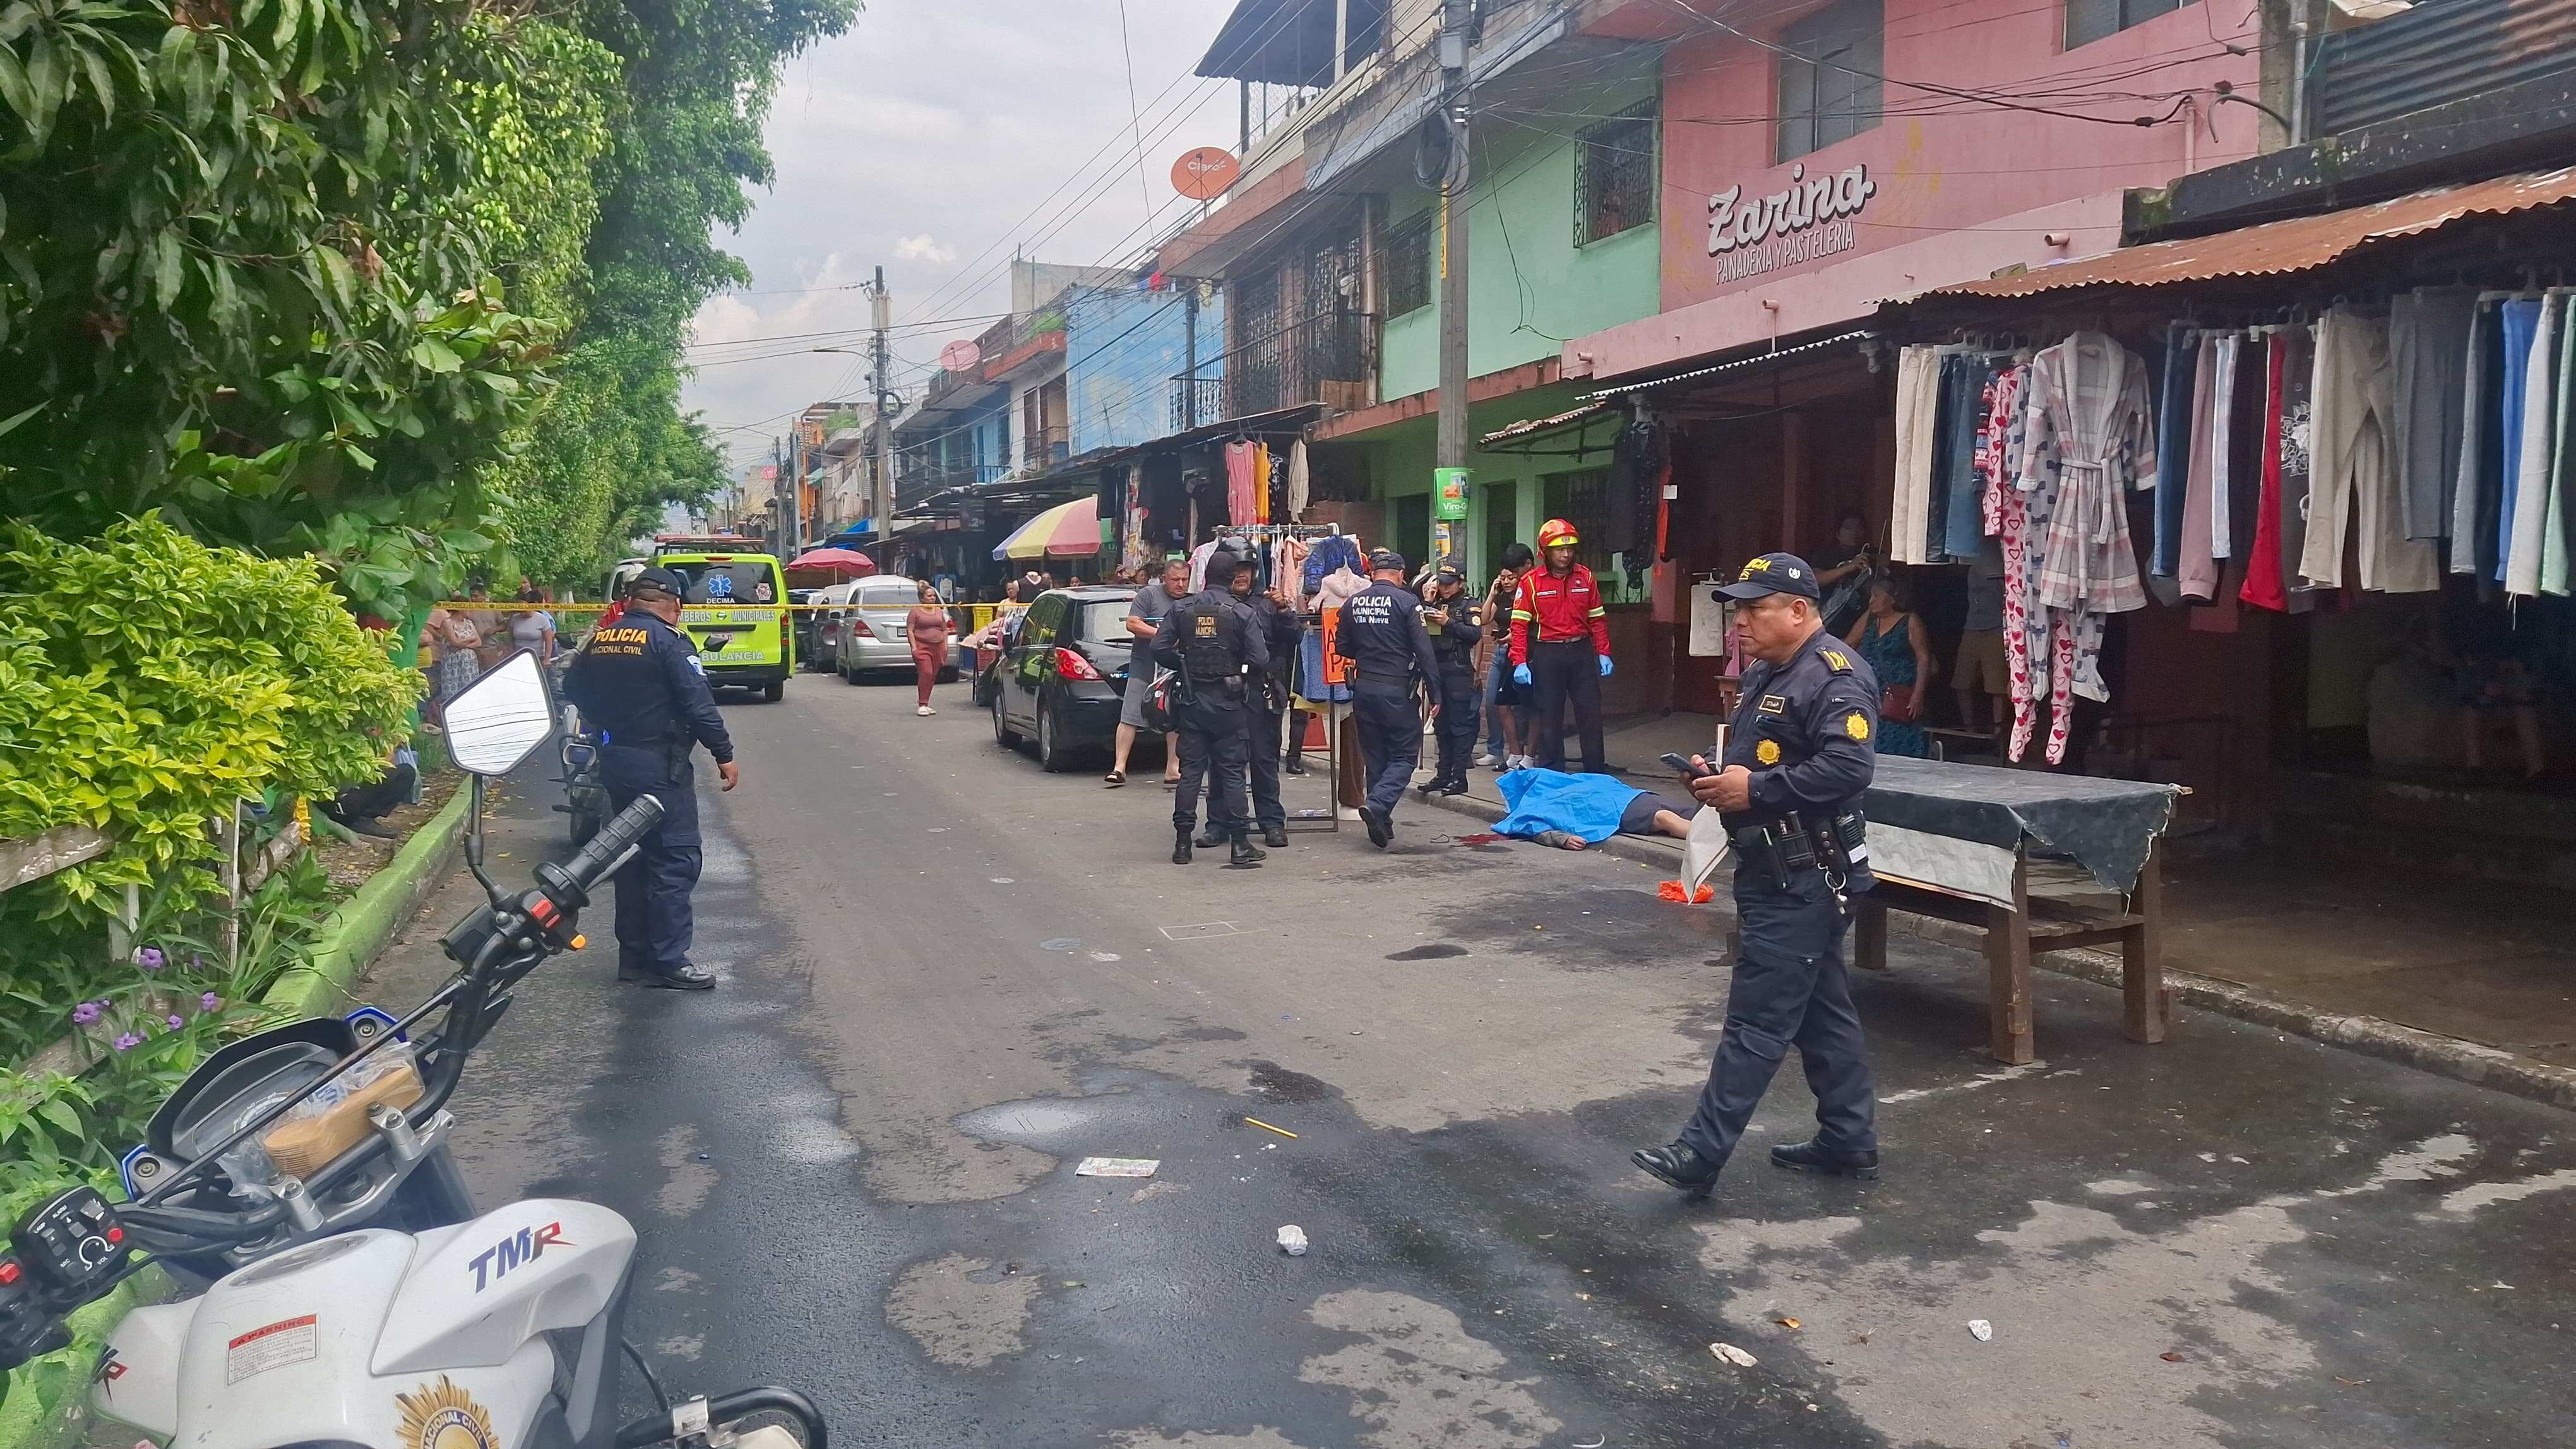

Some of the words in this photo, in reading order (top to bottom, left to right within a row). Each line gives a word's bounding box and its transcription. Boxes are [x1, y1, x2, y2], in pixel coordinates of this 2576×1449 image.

[1188, 162, 1220, 171] Claro
[1708, 163, 1877, 258] Zarina
[1717, 243, 1774, 285] PANADERIA
[1775, 242, 1786, 270] Y
[1784, 220, 1855, 267] PASTELERIA
[1352, 595, 1392, 607] POLICIA
[731, 610, 775, 623] MUNICIPALES
[1352, 607, 1390, 616] MUNICIPAL
[1354, 616, 1367, 624] Villa
[1368, 616, 1389, 624] Nueva
[594, 628, 647, 644] POLICIA
[623, 645, 643, 655] CIVIL
[97, 1256, 109, 1265] VOL
[468, 1221, 578, 1294] TMR
[462, 1415, 484, 1445] CIVIL
